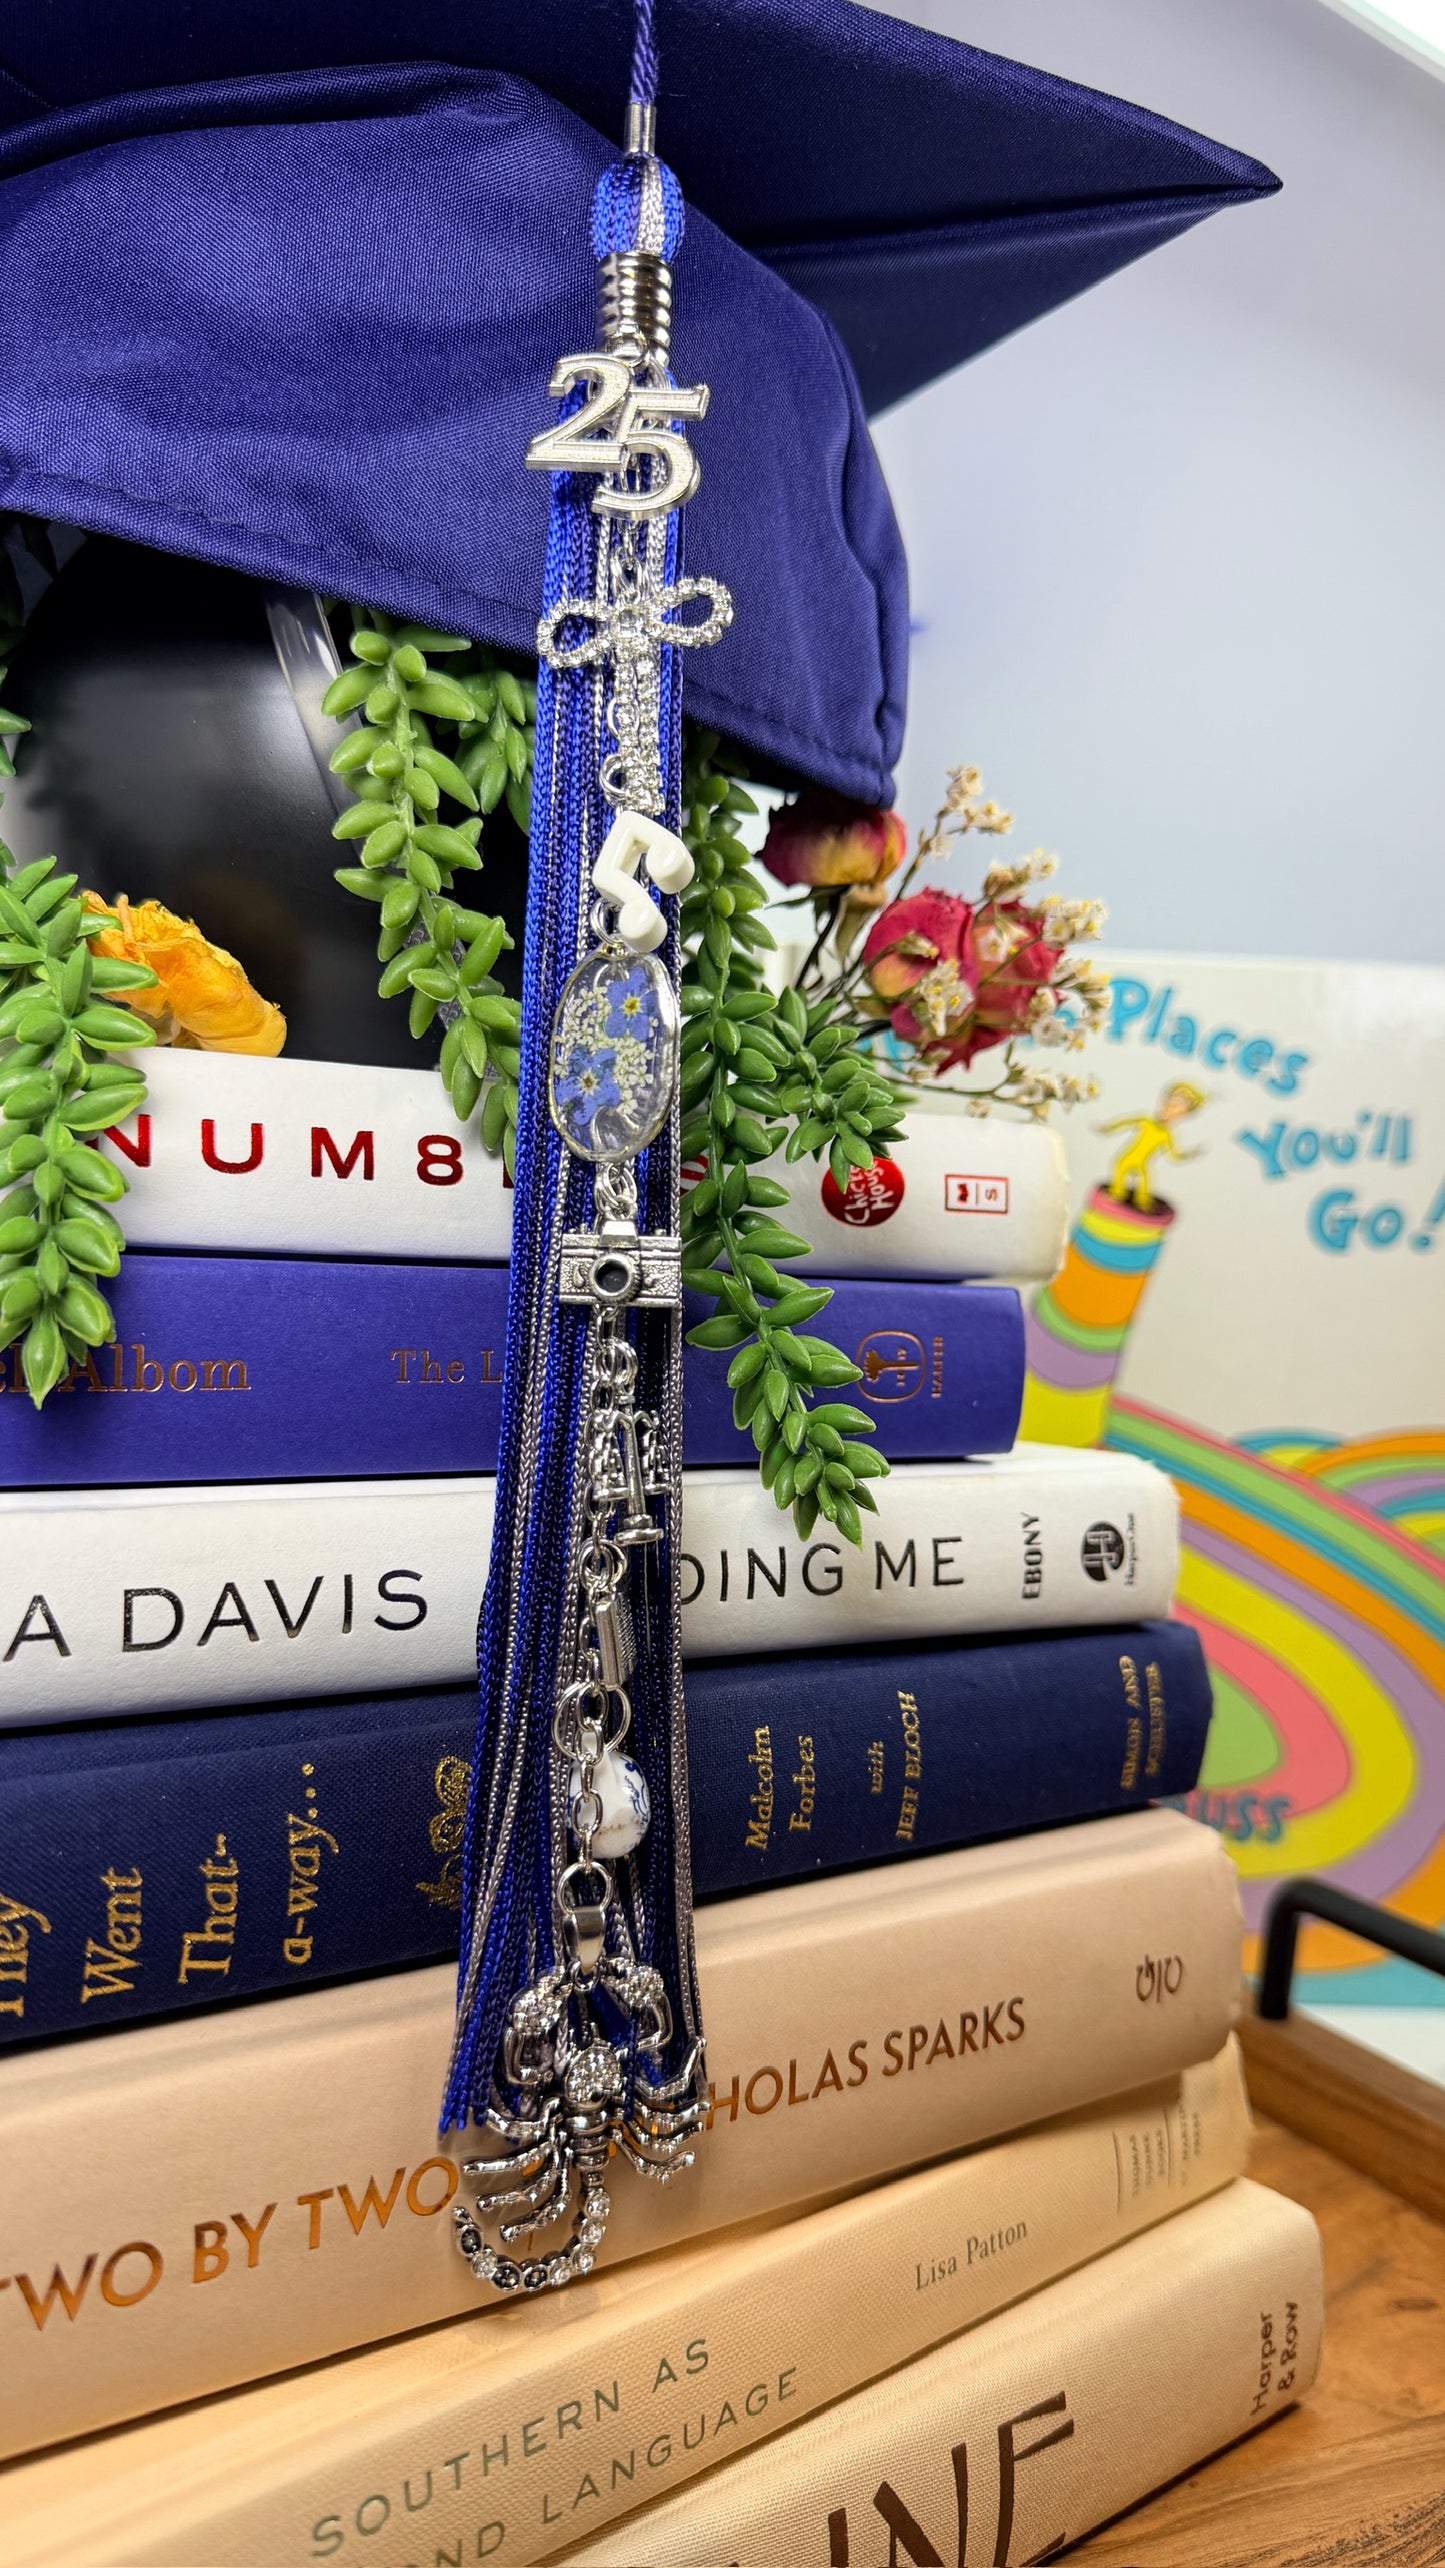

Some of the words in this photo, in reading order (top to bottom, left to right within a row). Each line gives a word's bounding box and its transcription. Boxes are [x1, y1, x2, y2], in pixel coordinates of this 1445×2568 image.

[525, 352, 709, 521] 25
[1105, 972, 1309, 1099] Places
[1236, 1111, 1412, 1180] You'll
[57, 1343, 252, 1393] Albom
[391, 1349, 465, 1384] The
[121, 1569, 430, 1653] DAVIS
[875, 1536, 965, 1591] ME
[1020, 1511, 1043, 1600] EBONY
[1118, 1655, 1142, 1711] AND
[866, 1740, 885, 1794] with
[897, 1690, 922, 1779] BLOCH
[745, 1725, 774, 1851] Malcolm
[789, 1735, 816, 1832] Forbes
[895, 1785, 920, 1841] JEFF
[79, 1866, 144, 2004] Went
[193, 2202, 278, 2284] BY
[297, 2156, 459, 2250] TWO
[881, 1996, 1026, 2077] SPARKS
[916, 2256, 958, 2292] Lisa
[966, 2220, 1028, 2266] Patton
[1249, 2310, 1276, 2416] Harper
[1279, 2301, 1298, 2366] Row
[311, 2381, 621, 2558] SOUTHERN
[652, 2338, 710, 2394] AS
[541, 2366, 798, 2525] LANGUAGE
